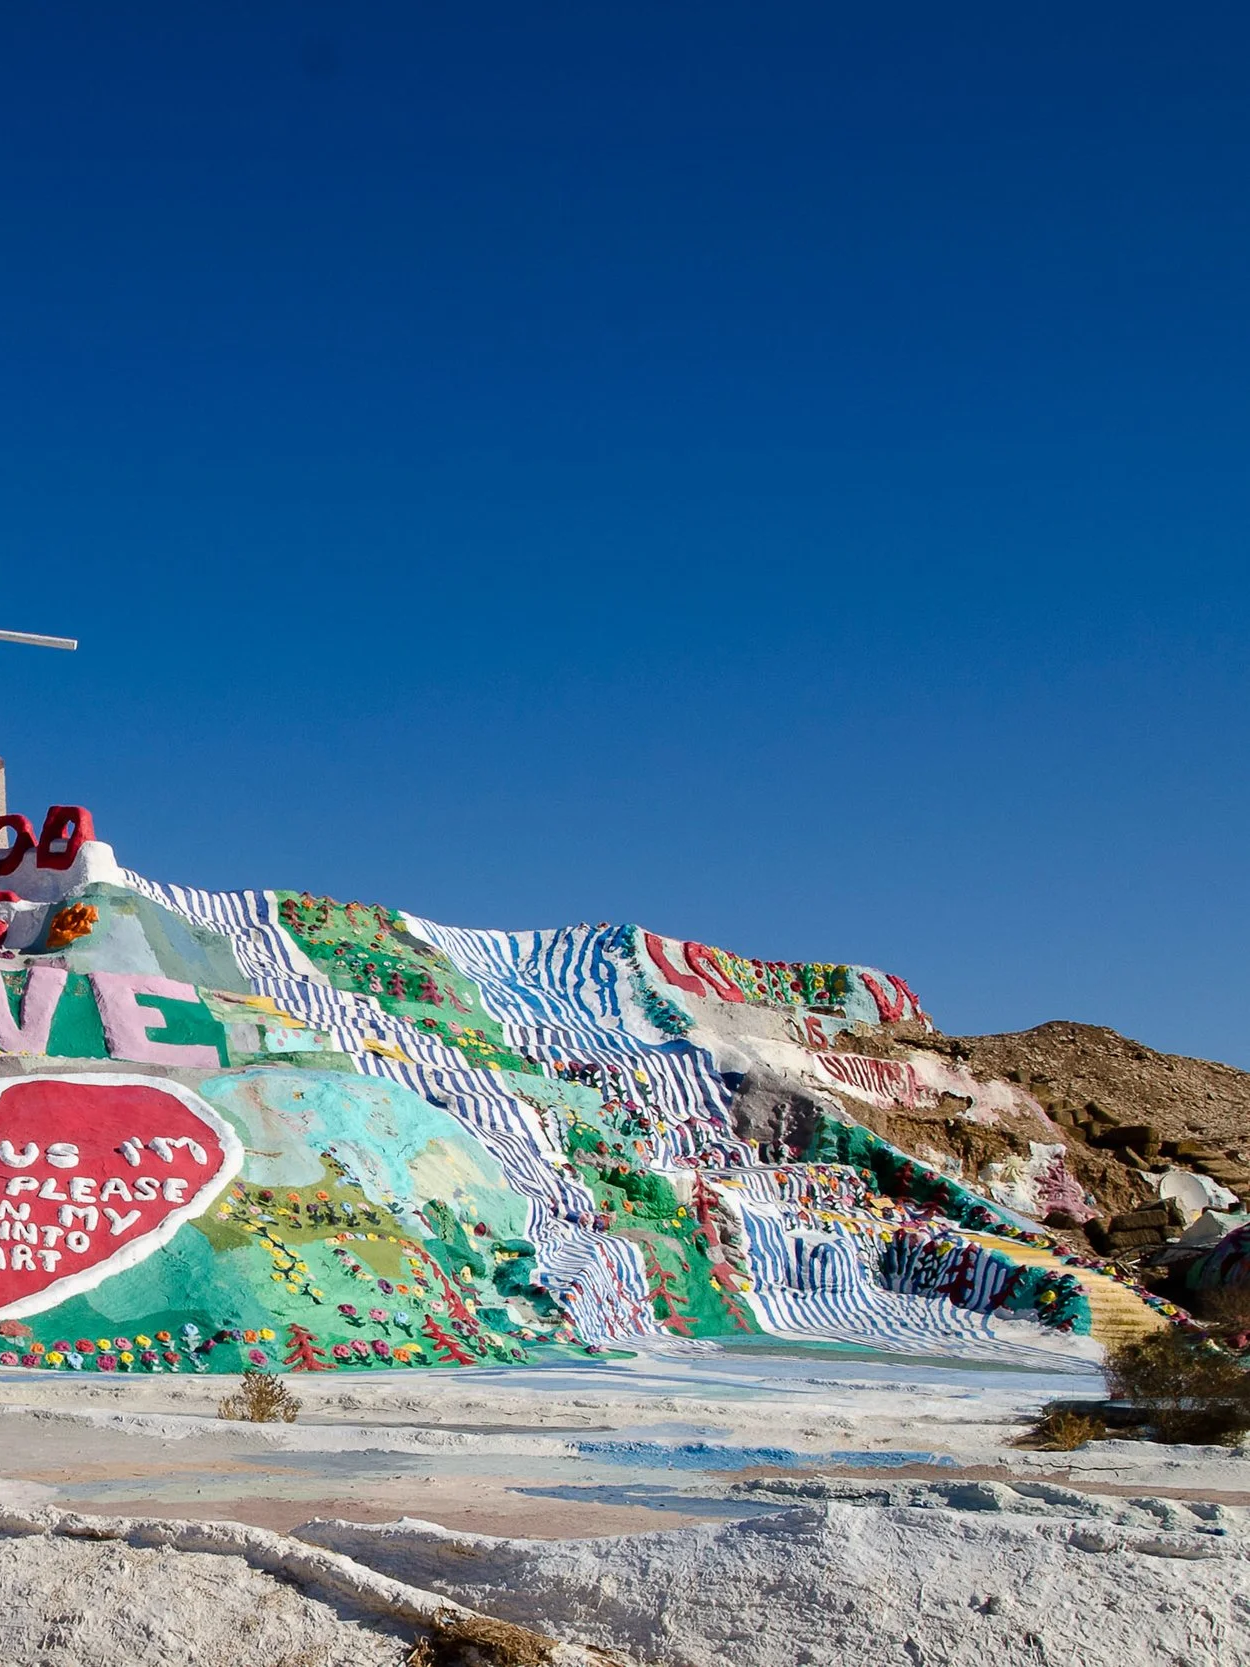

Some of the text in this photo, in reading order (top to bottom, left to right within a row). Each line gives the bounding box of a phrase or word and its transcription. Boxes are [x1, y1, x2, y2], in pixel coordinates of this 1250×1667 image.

[120, 1136, 208, 1167] I'M
[5, 1176, 189, 1203] PLEASE
[58, 1203, 142, 1236] MY
